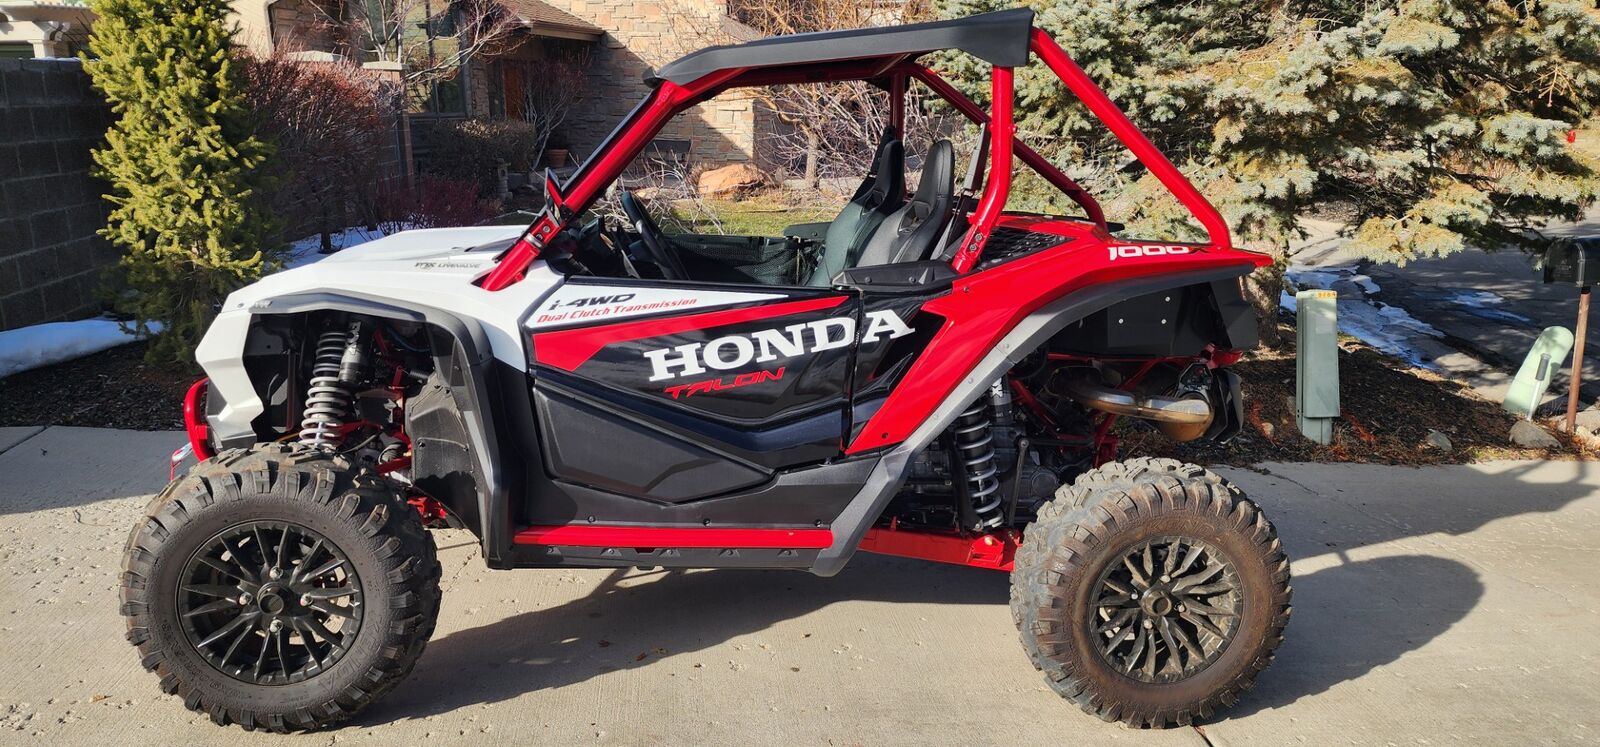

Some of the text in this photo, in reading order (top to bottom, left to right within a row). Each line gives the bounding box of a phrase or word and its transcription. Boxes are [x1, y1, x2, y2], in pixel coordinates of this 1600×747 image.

[537, 298, 698, 323] Dual Clutch Transmission
[548, 293, 636, 311] i-4WD
[643, 308, 916, 382] HONDA
[664, 367, 786, 400] TALON
